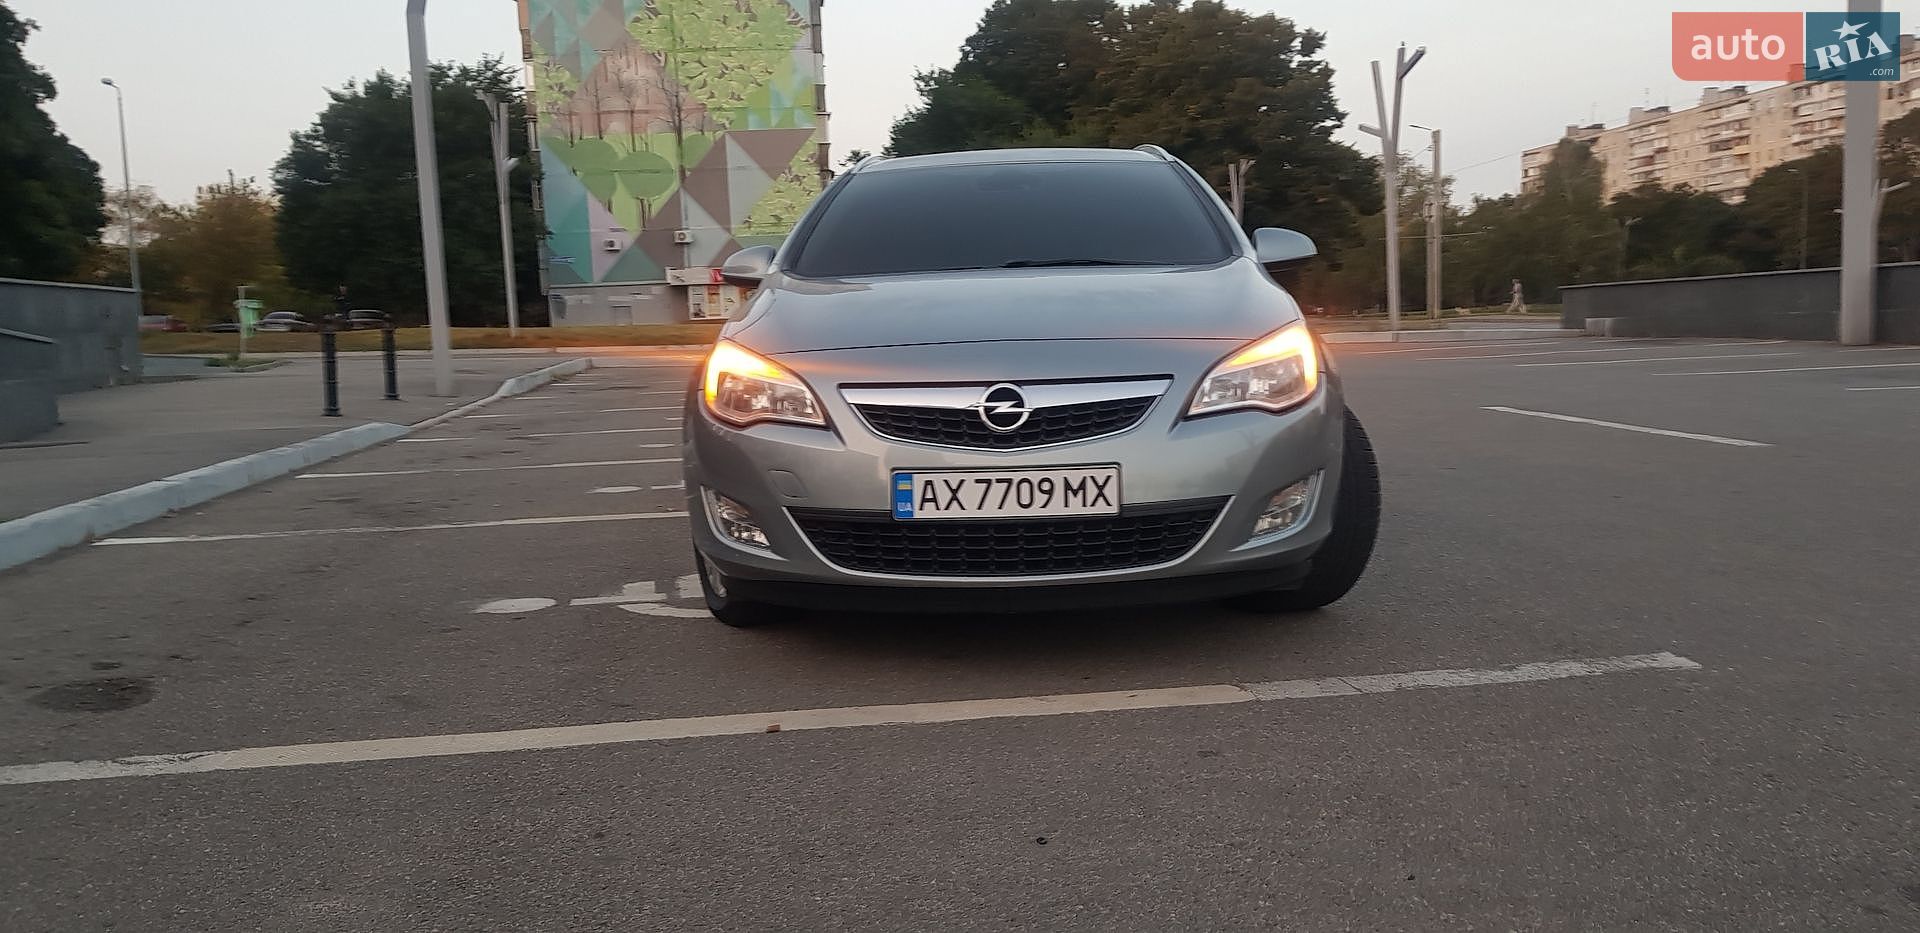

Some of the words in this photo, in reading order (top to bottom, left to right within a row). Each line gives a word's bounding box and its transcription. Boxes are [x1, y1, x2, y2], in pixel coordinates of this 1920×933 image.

[919, 478, 967, 511] AX
[974, 477, 1054, 511] 7709
[1063, 475, 1113, 508] MX
[897, 502, 913, 512] UA
